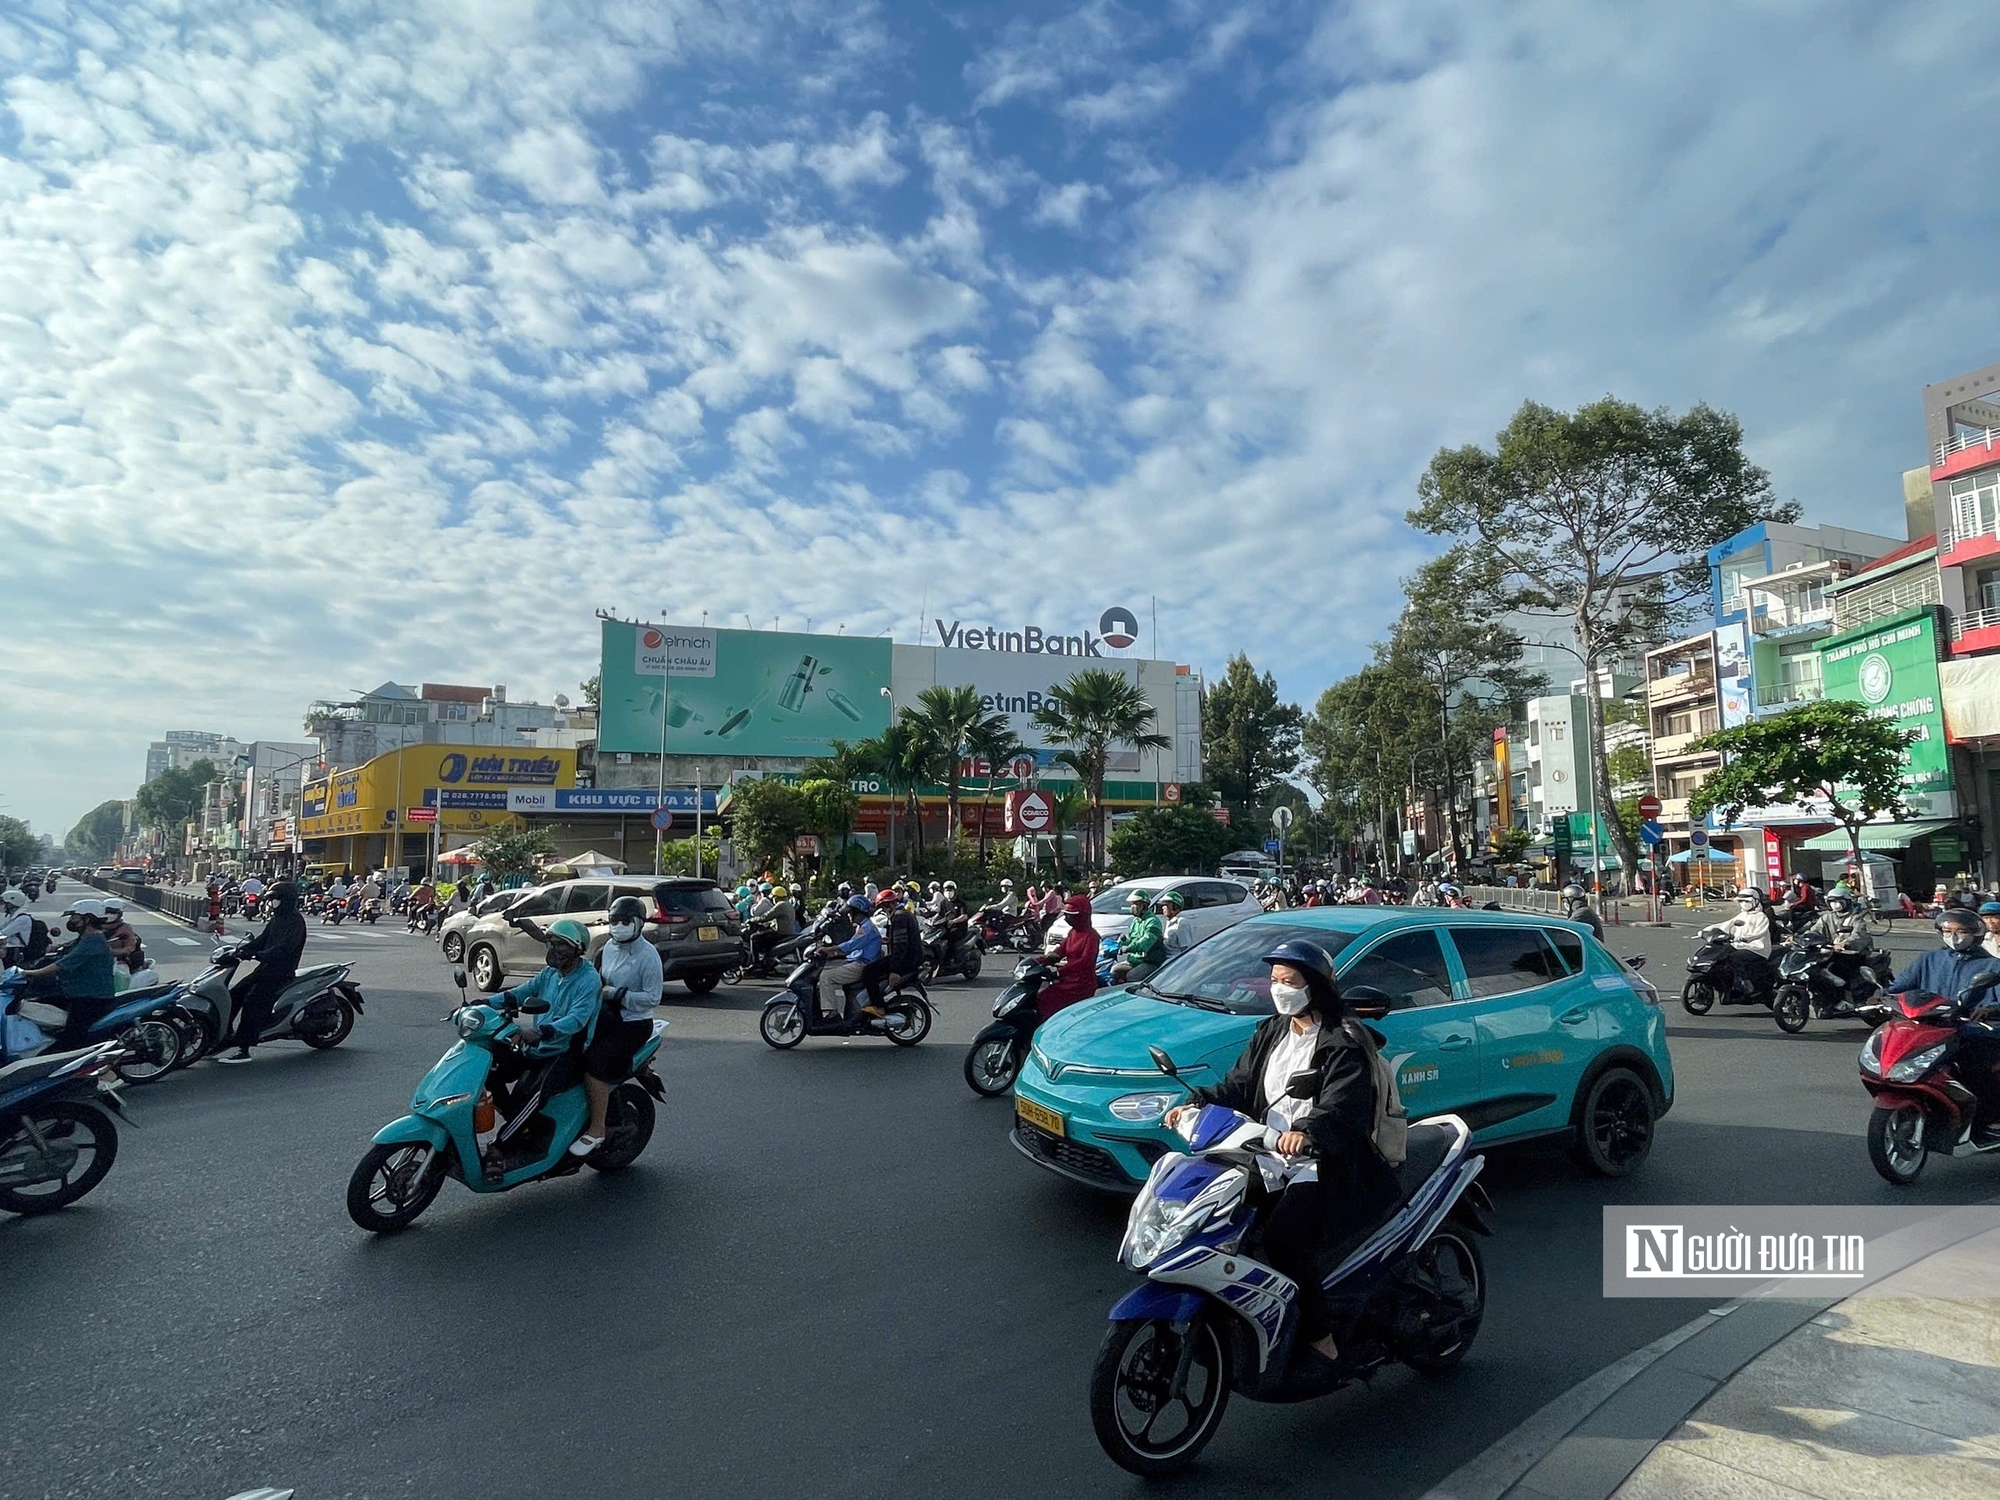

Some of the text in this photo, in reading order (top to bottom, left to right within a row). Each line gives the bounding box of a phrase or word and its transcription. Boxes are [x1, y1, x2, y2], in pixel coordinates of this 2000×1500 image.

[665, 635, 710, 648] elmich
[935, 619, 1102, 657] VietinBank
[1826, 647, 1850, 663] THÀNH
[1851, 637, 1868, 656] PHỐ
[1868, 634, 1880, 650] HỒ
[1897, 624, 1921, 641] MINH
[1900, 696, 1934, 718] CHỨNG
[270, 780, 279, 815] KUMHO
[515, 795, 545, 804] Mobil
[569, 794, 602, 805] KHU
[608, 794, 640, 806] VỰC
[1401, 1069, 1439, 1085] XANH SM
